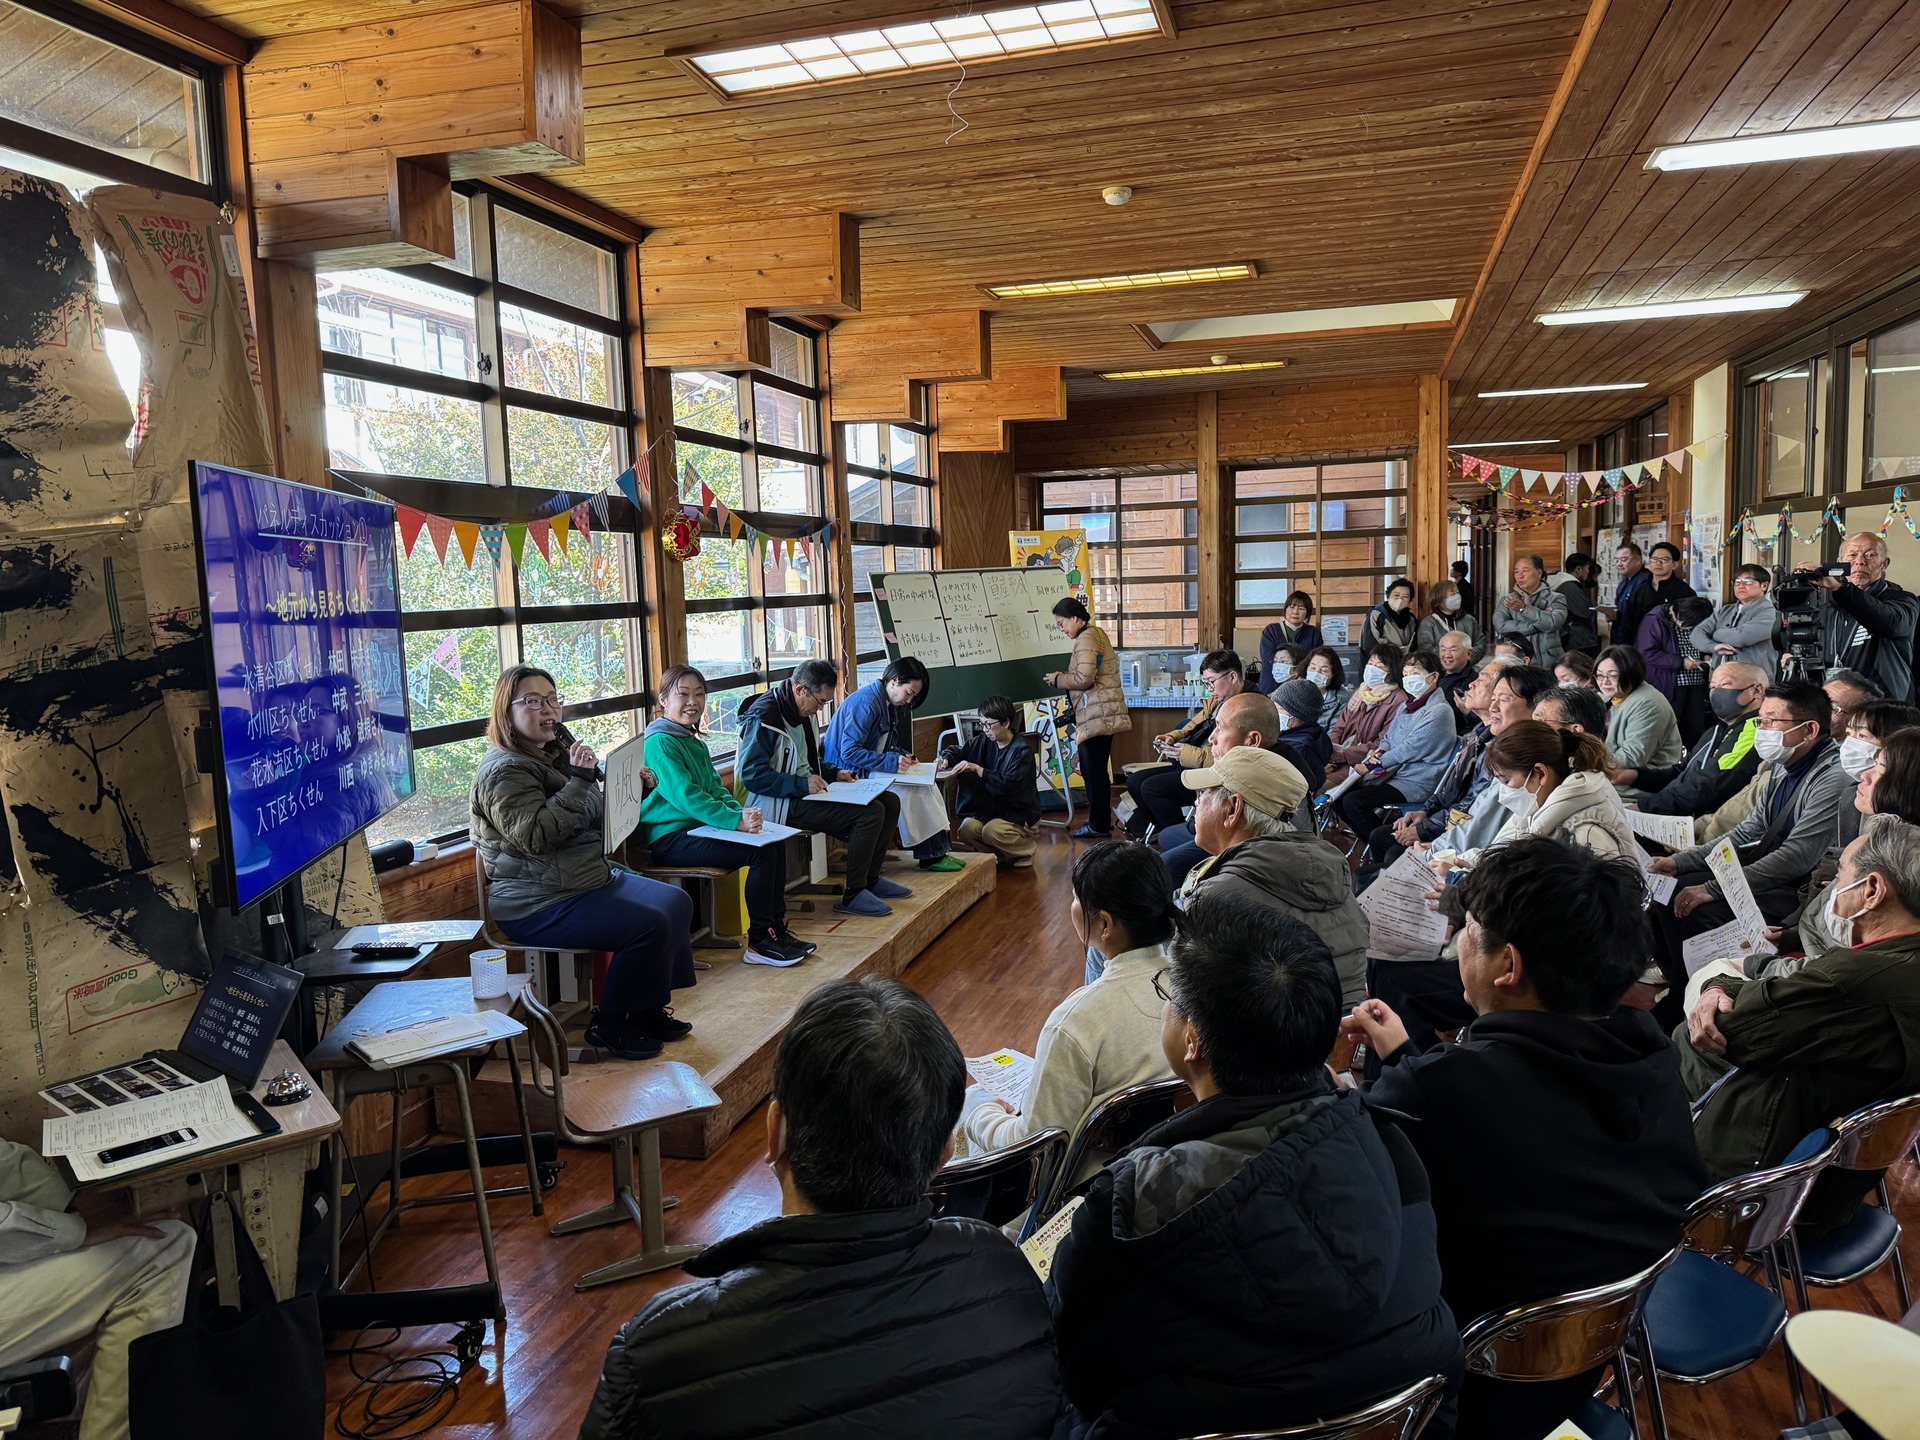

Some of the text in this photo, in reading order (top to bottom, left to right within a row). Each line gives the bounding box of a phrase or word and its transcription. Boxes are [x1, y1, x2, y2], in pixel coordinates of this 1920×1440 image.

[257, 502, 368, 544] パネルディスカッション①
[248, 697, 317, 741] 小川区ちくせん
[332, 688, 348, 716] 中武
[250, 736, 329, 790] 花水流区ちくせん
[336, 728, 352, 753] 小松
[256, 779, 324, 837] 入下区ちくせん
[338, 761, 355, 792] 川西
